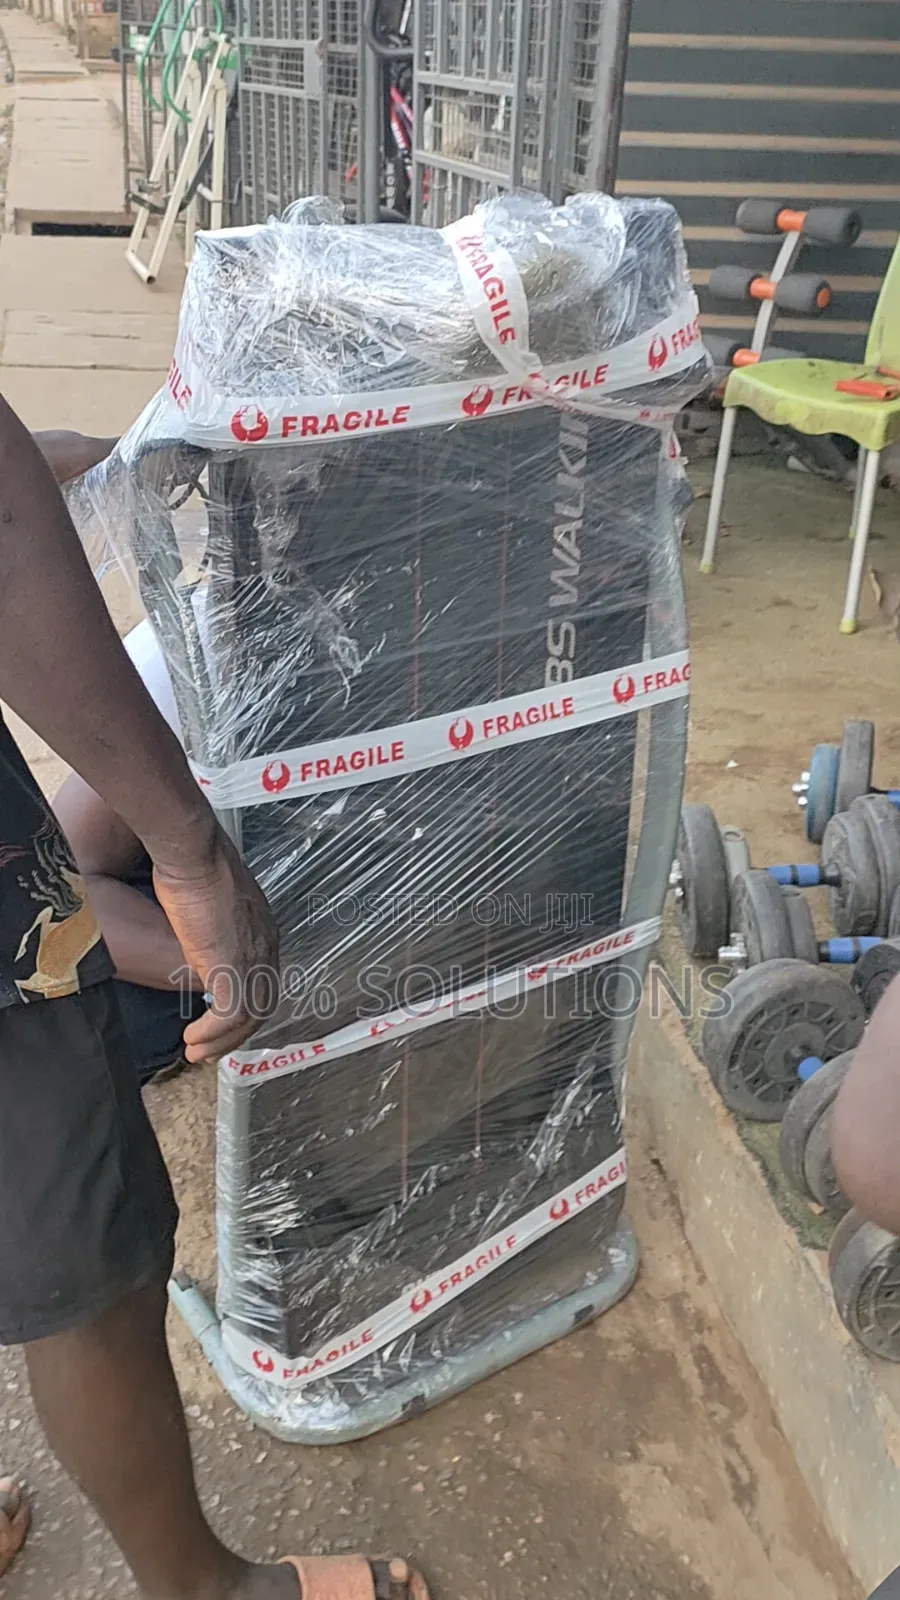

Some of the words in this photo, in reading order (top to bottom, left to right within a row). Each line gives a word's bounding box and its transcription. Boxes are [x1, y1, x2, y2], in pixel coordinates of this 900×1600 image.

[464, 247, 517, 345] FRAGILE
[281, 405, 411, 438] FRAGILE
[501, 363, 610, 406] FRGILE
[300, 740, 405, 782] FRAGILE
[483, 696, 575, 738] FRAGILE
[228, 1043, 326, 1076] FRAGILE
[556, 930, 636, 969] FRAGILE
[437, 1234, 517, 1294] FRAGILE
[575, 1161, 625, 1206] FRAGI
